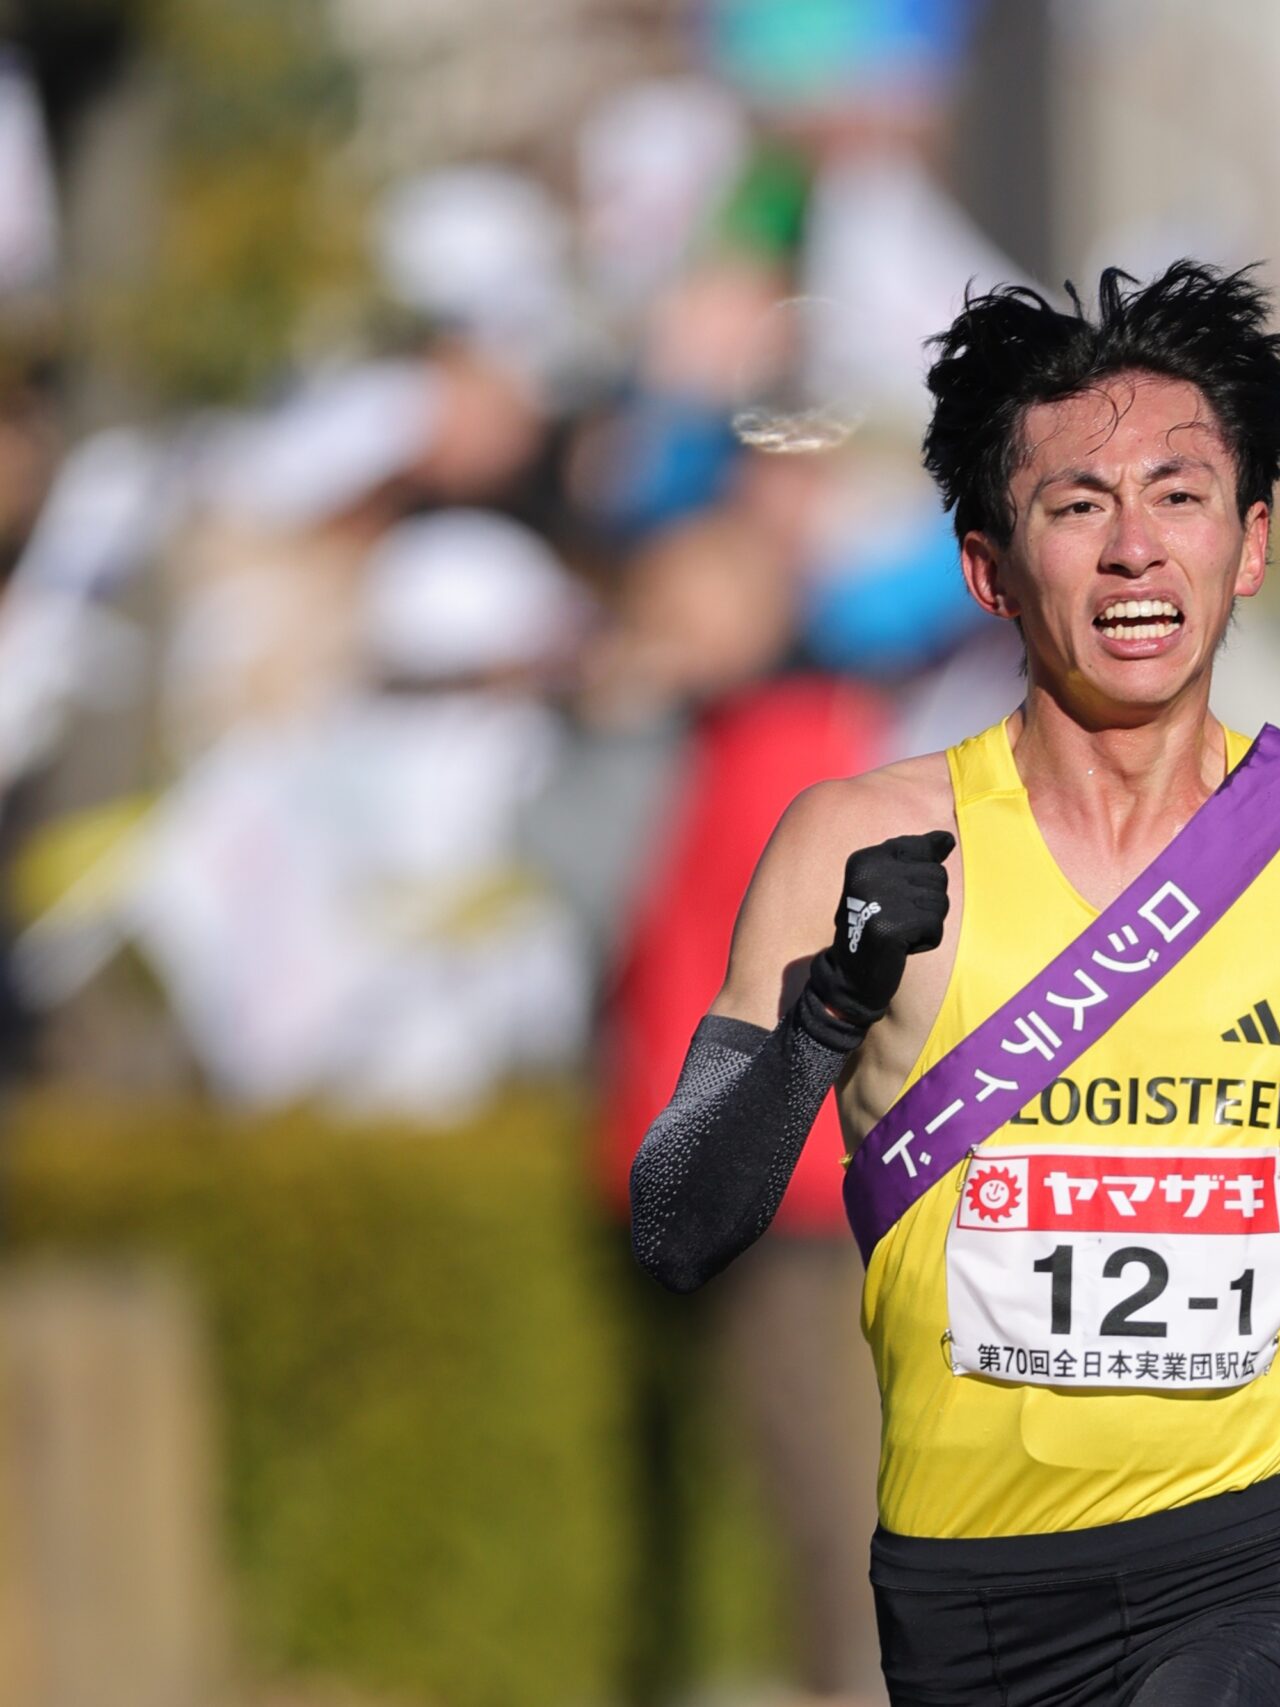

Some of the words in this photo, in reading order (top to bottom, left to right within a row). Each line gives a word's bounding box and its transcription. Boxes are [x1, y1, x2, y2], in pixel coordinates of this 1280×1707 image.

[882, 881, 1200, 1178] ロジスティード
[1043, 1171, 1265, 1219] ヤマザキ
[1033, 1244, 1255, 1338] 12-1
[977, 1343, 1260, 1381] 第70回全日本実業団駅伝
